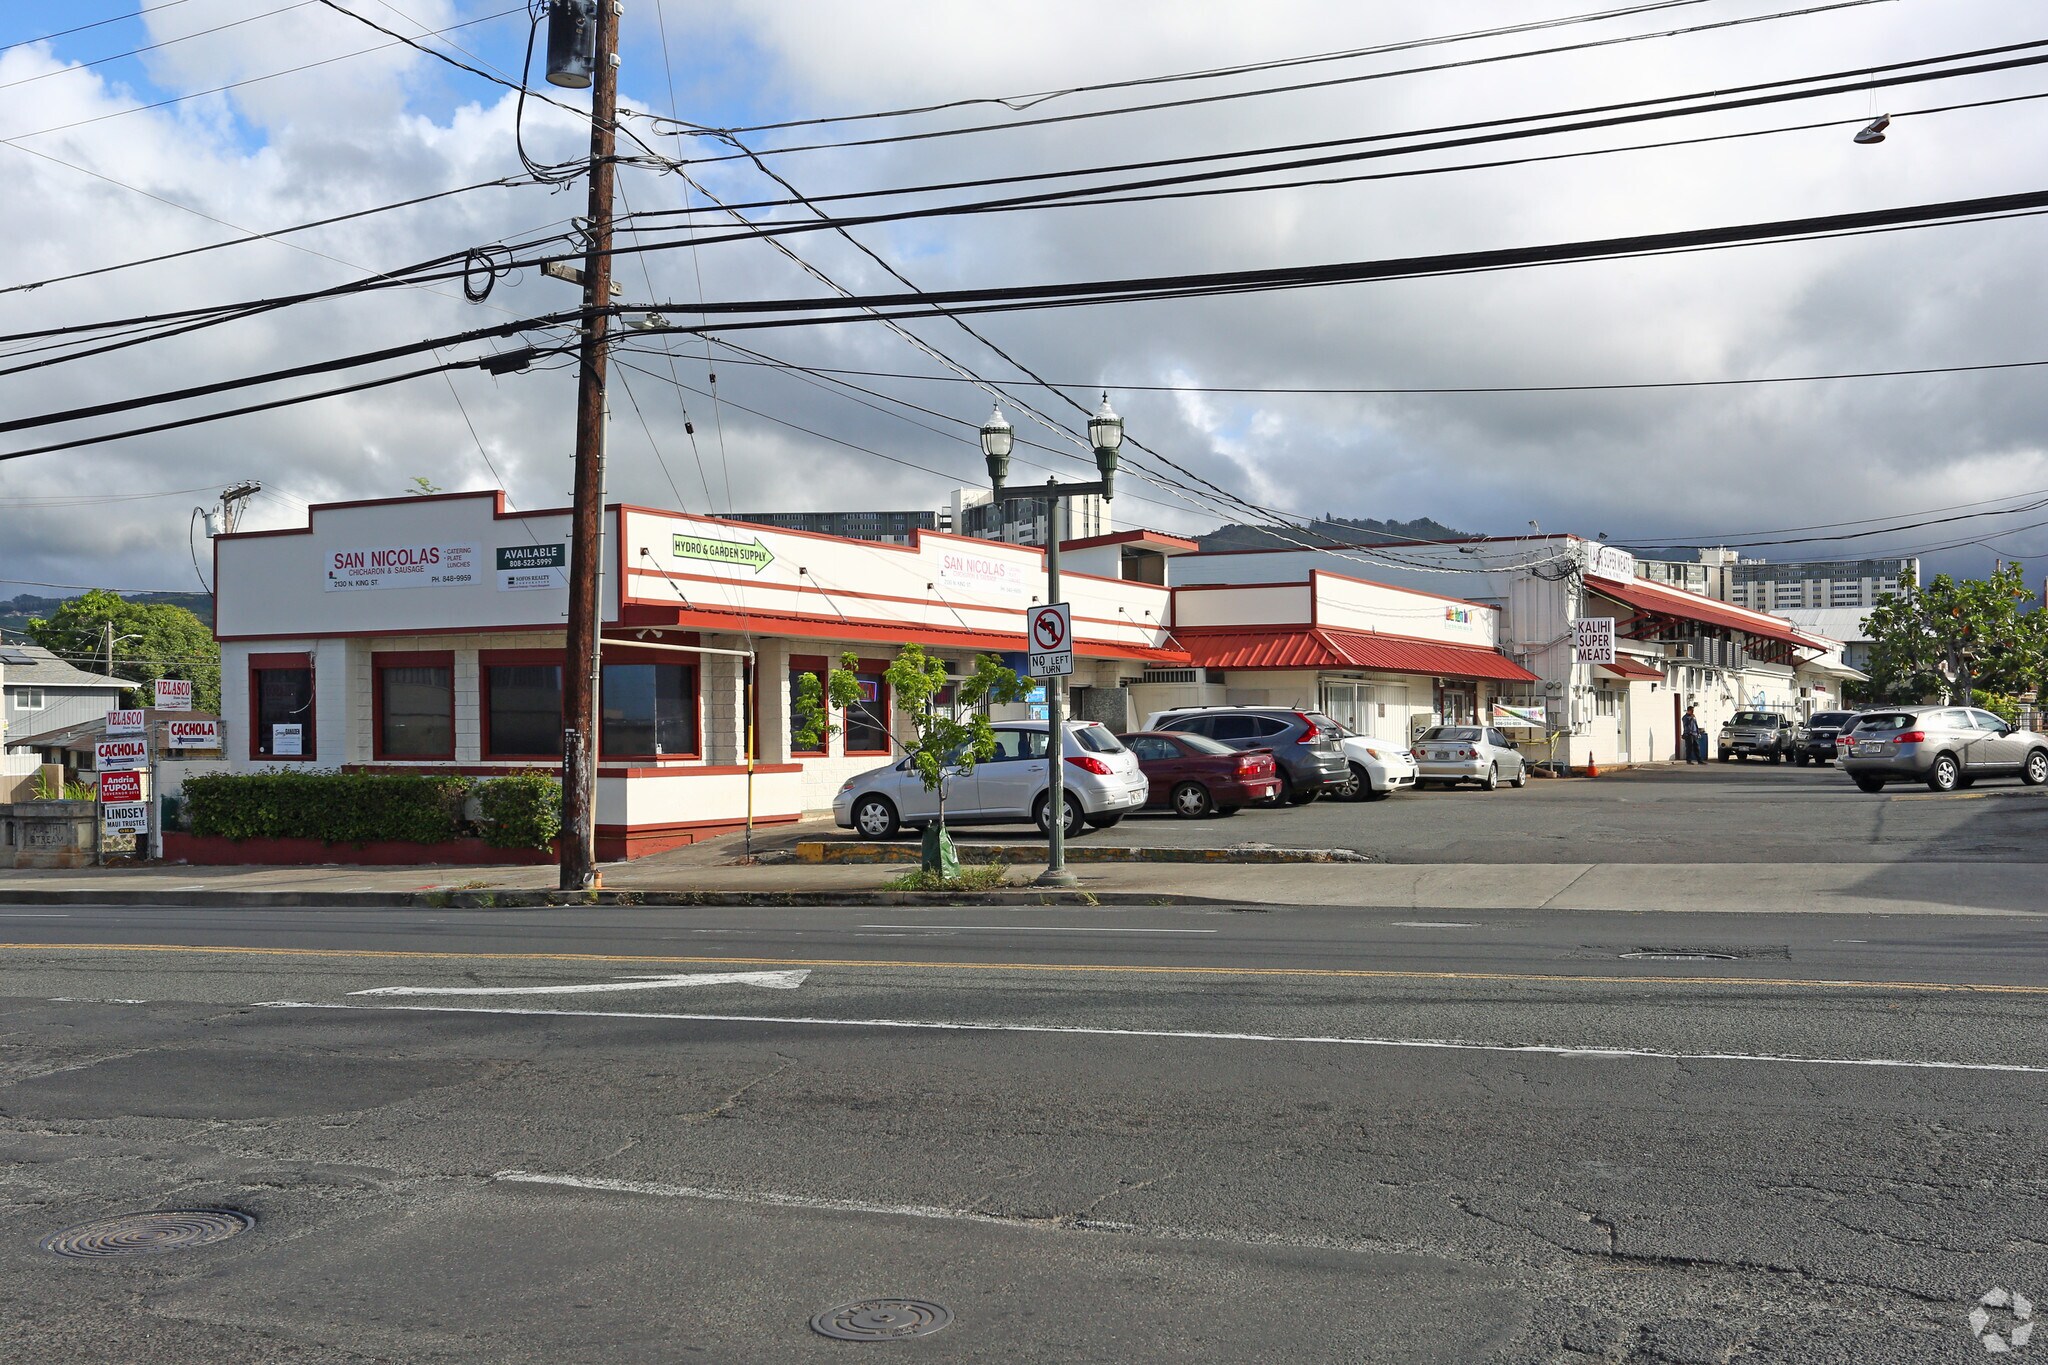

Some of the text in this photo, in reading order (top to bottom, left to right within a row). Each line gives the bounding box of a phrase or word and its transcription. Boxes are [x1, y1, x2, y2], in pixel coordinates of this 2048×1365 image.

[504, 547, 557, 559] AVAILABLE
[675, 540, 766, 562] HYDRO & GARDEN SUPPLY
[334, 547, 439, 569] SAN NICOLAS
[509, 558, 552, 567] 808-522-5999
[348, 568, 385, 576] CHICHARON
[394, 566, 424, 574] SAUSAGE
[944, 555, 962, 570] SAN
[967, 559, 1004, 576] NICOLAS
[442, 575, 471, 583] 848-9959
[1578, 621, 1610, 633] KALIHI
[1579, 635, 1609, 647] SUPER
[1578, 648, 1610, 660] MEATS
[1033, 655, 1068, 666] NO LEFT
[1042, 665, 1060, 674] TURN
[157, 681, 190, 695] VELASCO
[108, 711, 142, 725] VELASCO
[171, 723, 214, 735] CACHOLA
[98, 743, 145, 757] CACHOLA
[107, 775, 134, 783] Andria
[103, 783, 139, 792] TUPOLA
[107, 807, 144, 819] LINDSEY
